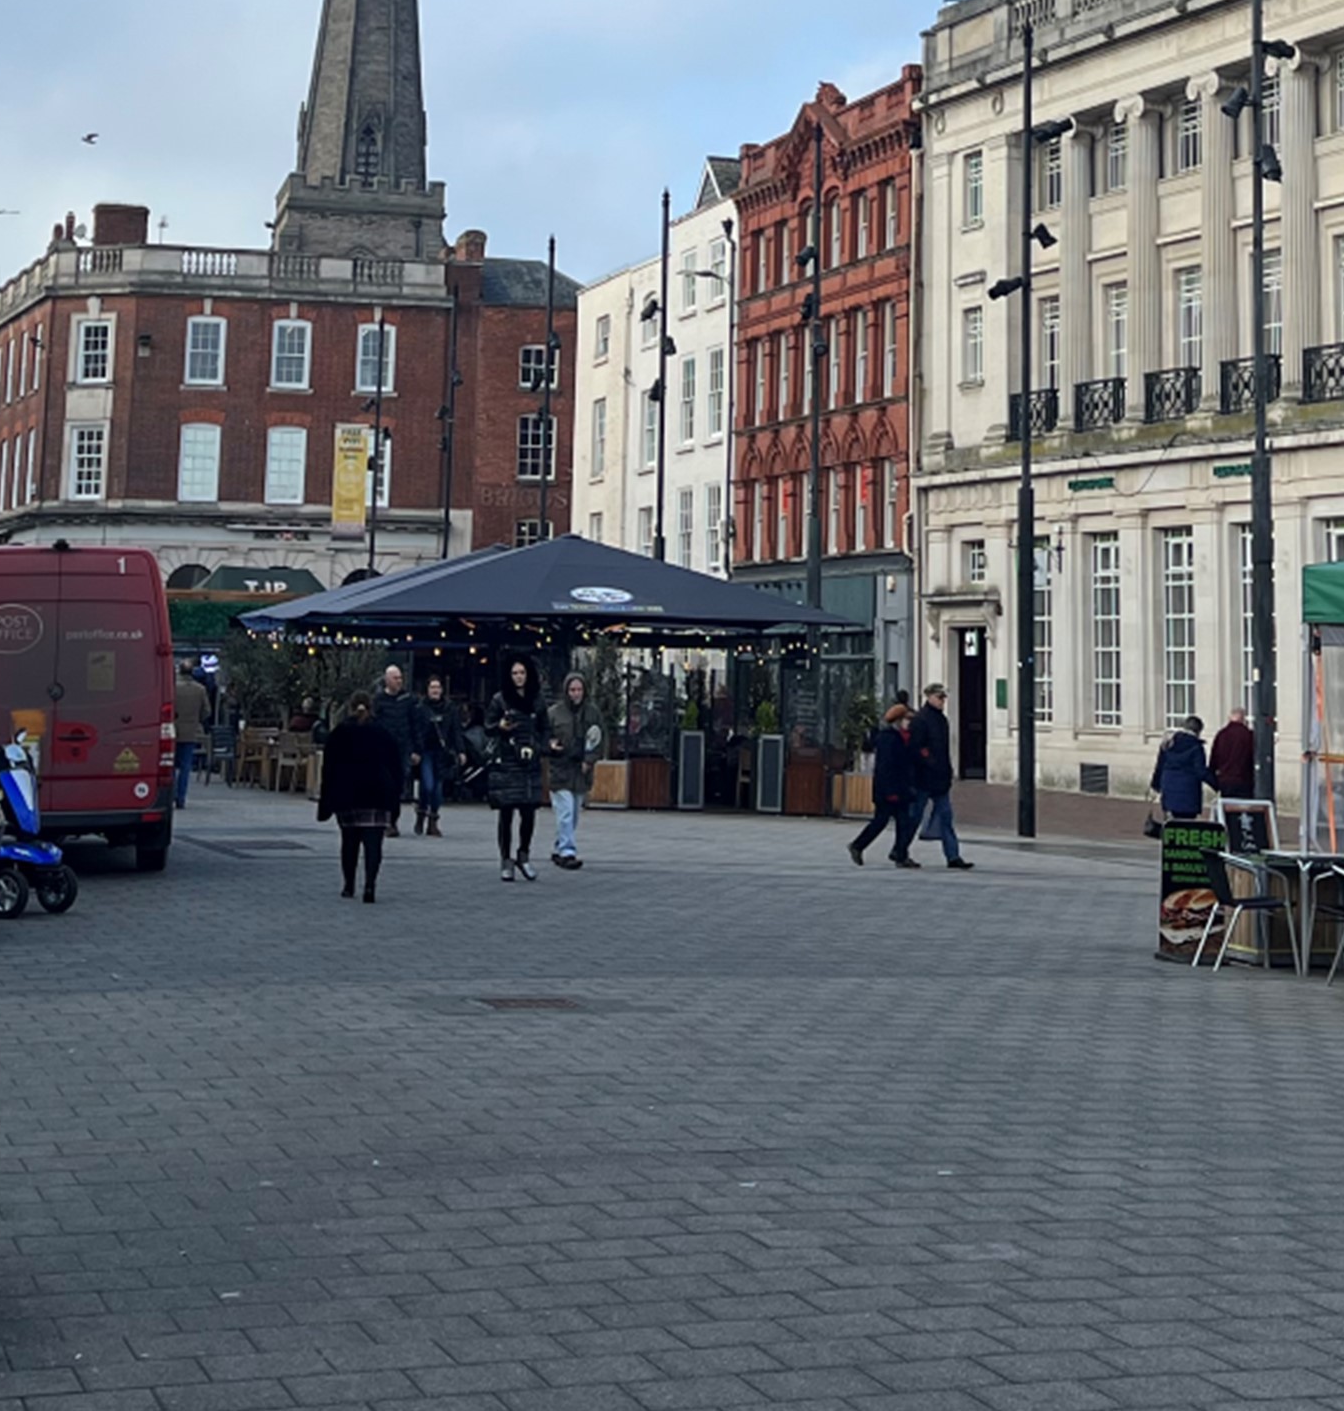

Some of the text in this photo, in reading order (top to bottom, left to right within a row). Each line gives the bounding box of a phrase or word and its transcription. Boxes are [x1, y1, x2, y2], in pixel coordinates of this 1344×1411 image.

[117, 556, 127, 574] 1
[65, 628, 143, 640] postoffice.co.uk
[1164, 829, 1227, 847] FRESH
